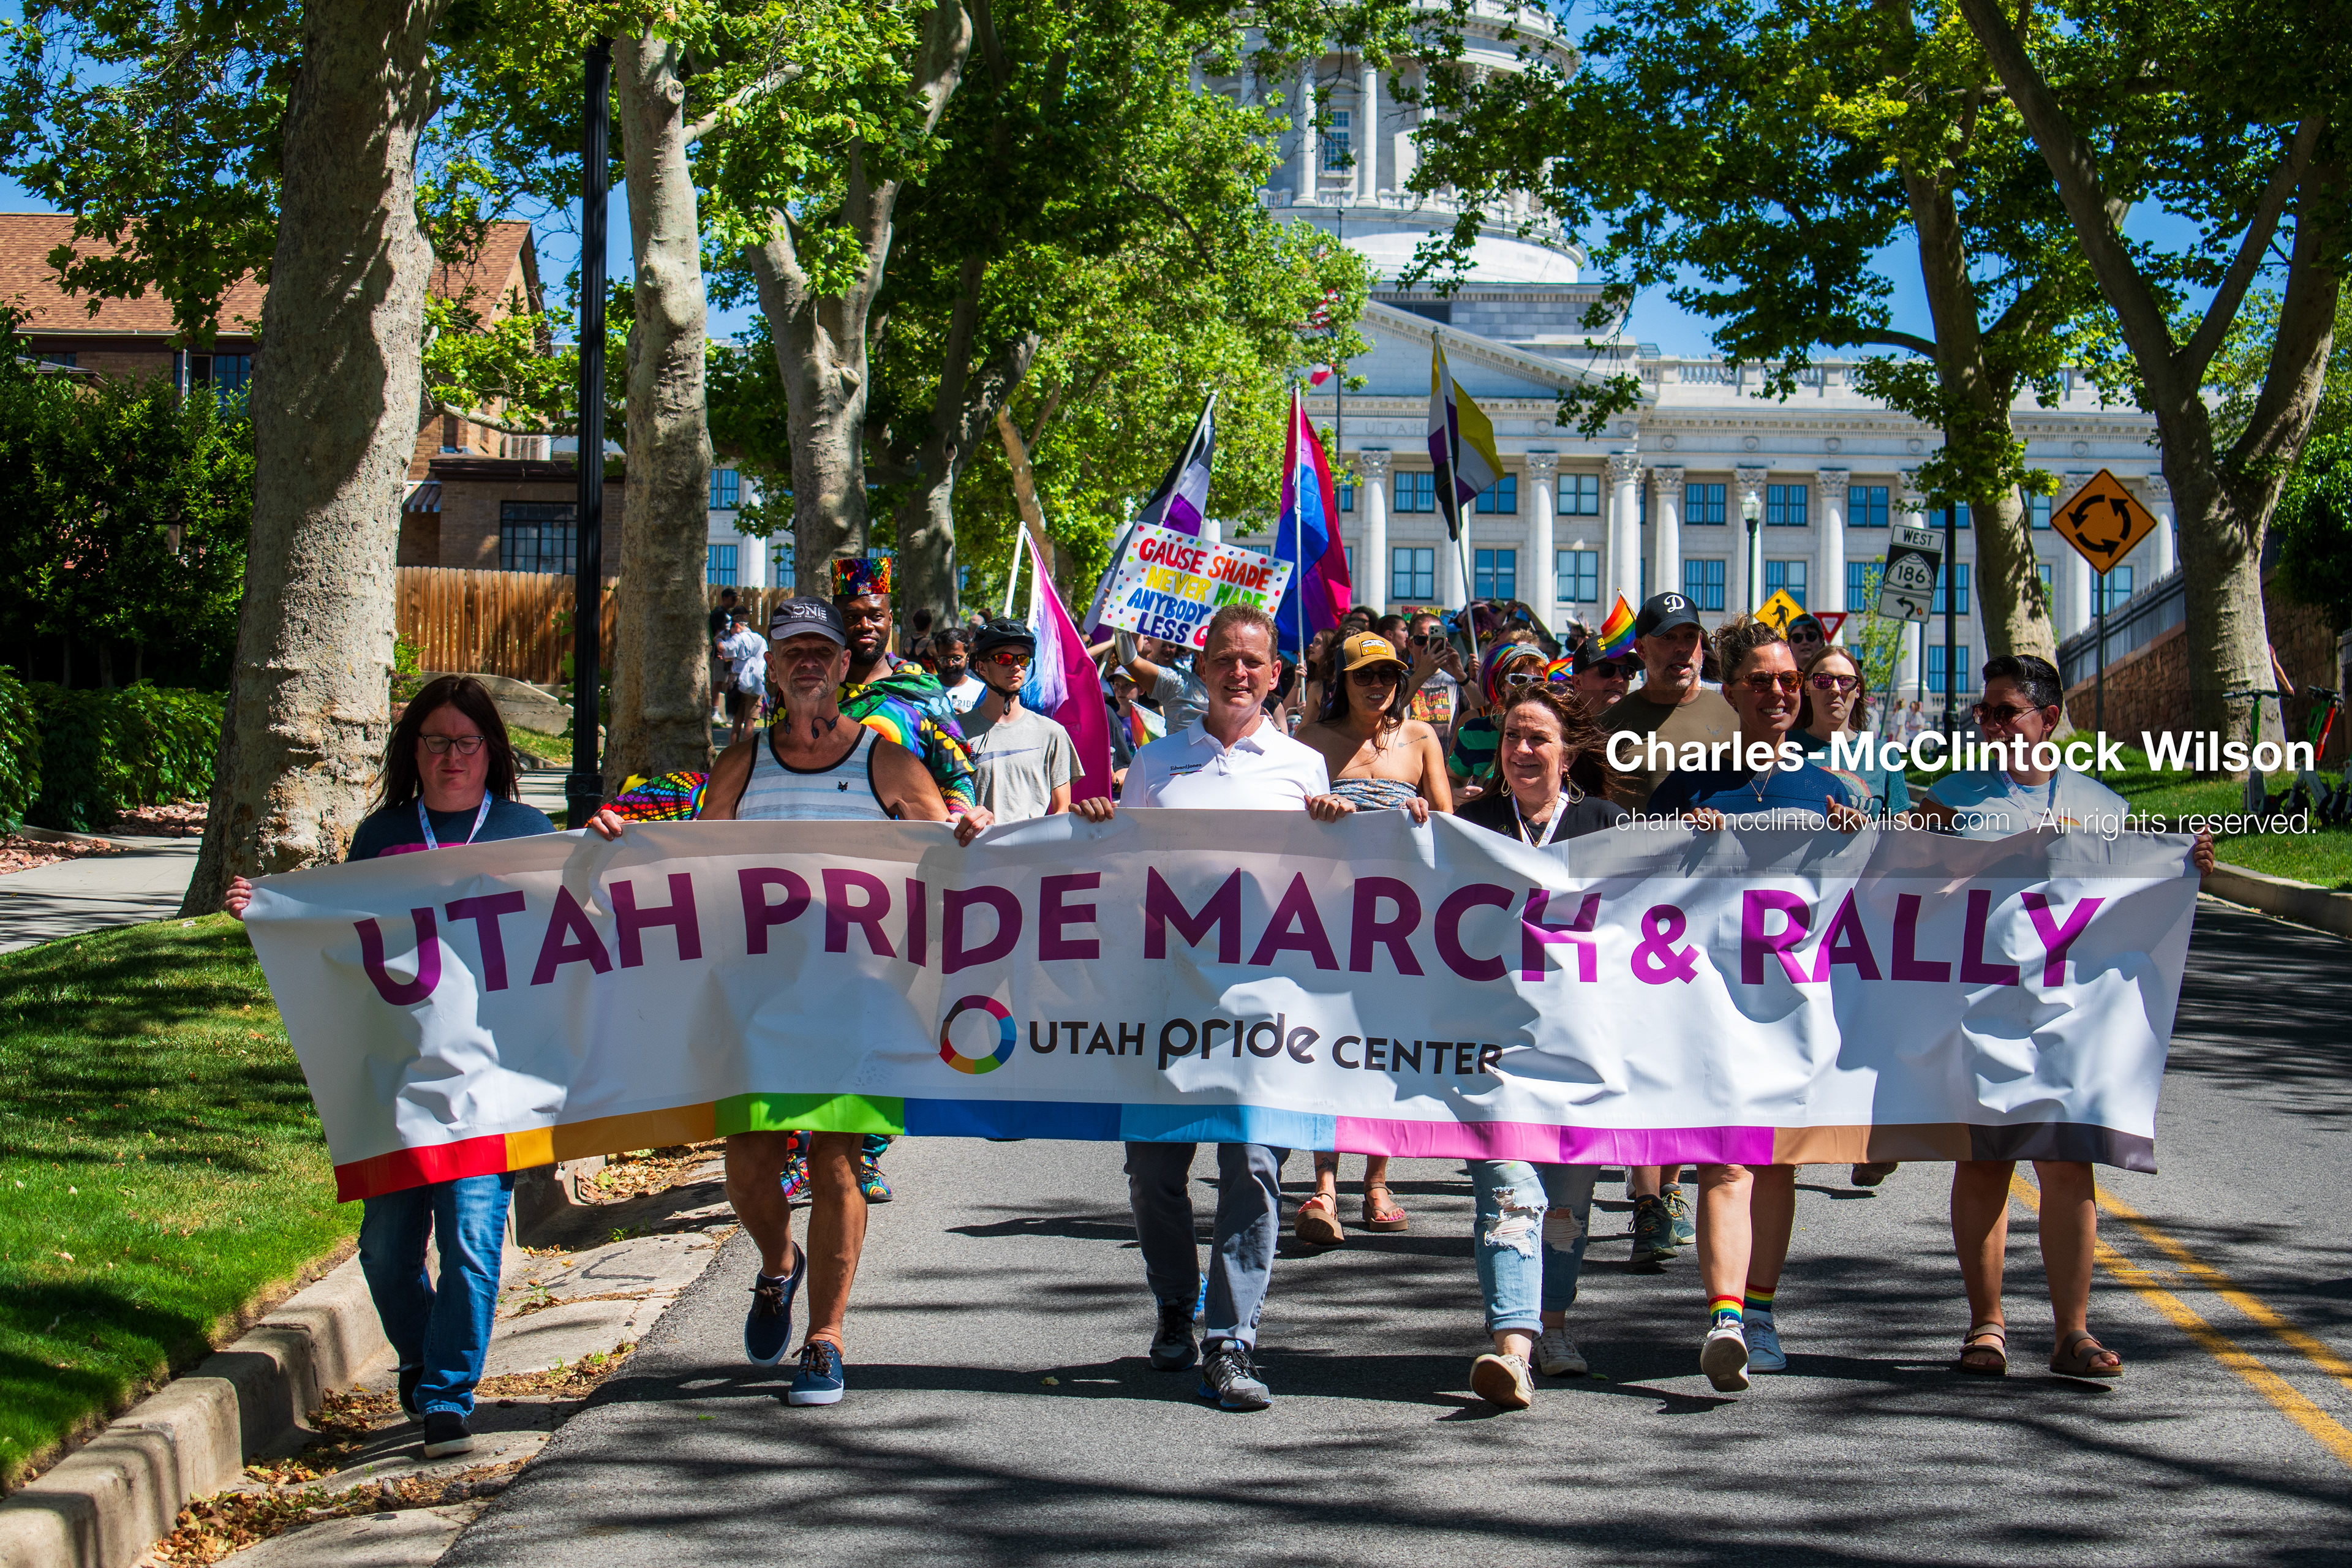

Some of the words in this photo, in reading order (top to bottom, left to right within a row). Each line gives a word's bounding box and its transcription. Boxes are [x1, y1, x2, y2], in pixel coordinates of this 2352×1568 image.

[1365, 422, 1424, 434] UTAH
[1904, 529, 1934, 546] WEST
[1139, 538, 1208, 575] CAUSE
[1208, 556, 1273, 591] SHADE
[1898, 565, 1926, 583] 186
[1145, 565, 1212, 603] NEVER
[1213, 583, 1268, 610] MADE
[793, 605, 827, 619] ONE
[1127, 587, 1212, 625] ANYBODY
[1664, 594, 1686, 613] D
[1137, 612, 1191, 643] LESS
[1430, 698, 1450, 707] UNTIL
[353, 872, 703, 1006] UTAH
[737, 867, 1101, 974] PRIDE
[1144, 865, 1602, 983] MARCH
[1630, 903, 1700, 984] &
[1740, 887, 2105, 988] RALLY
[1029, 1021, 1145, 1056] UTAH
[1158, 1012, 1321, 1071] pride
[1332, 1035, 1503, 1075] CENTER
